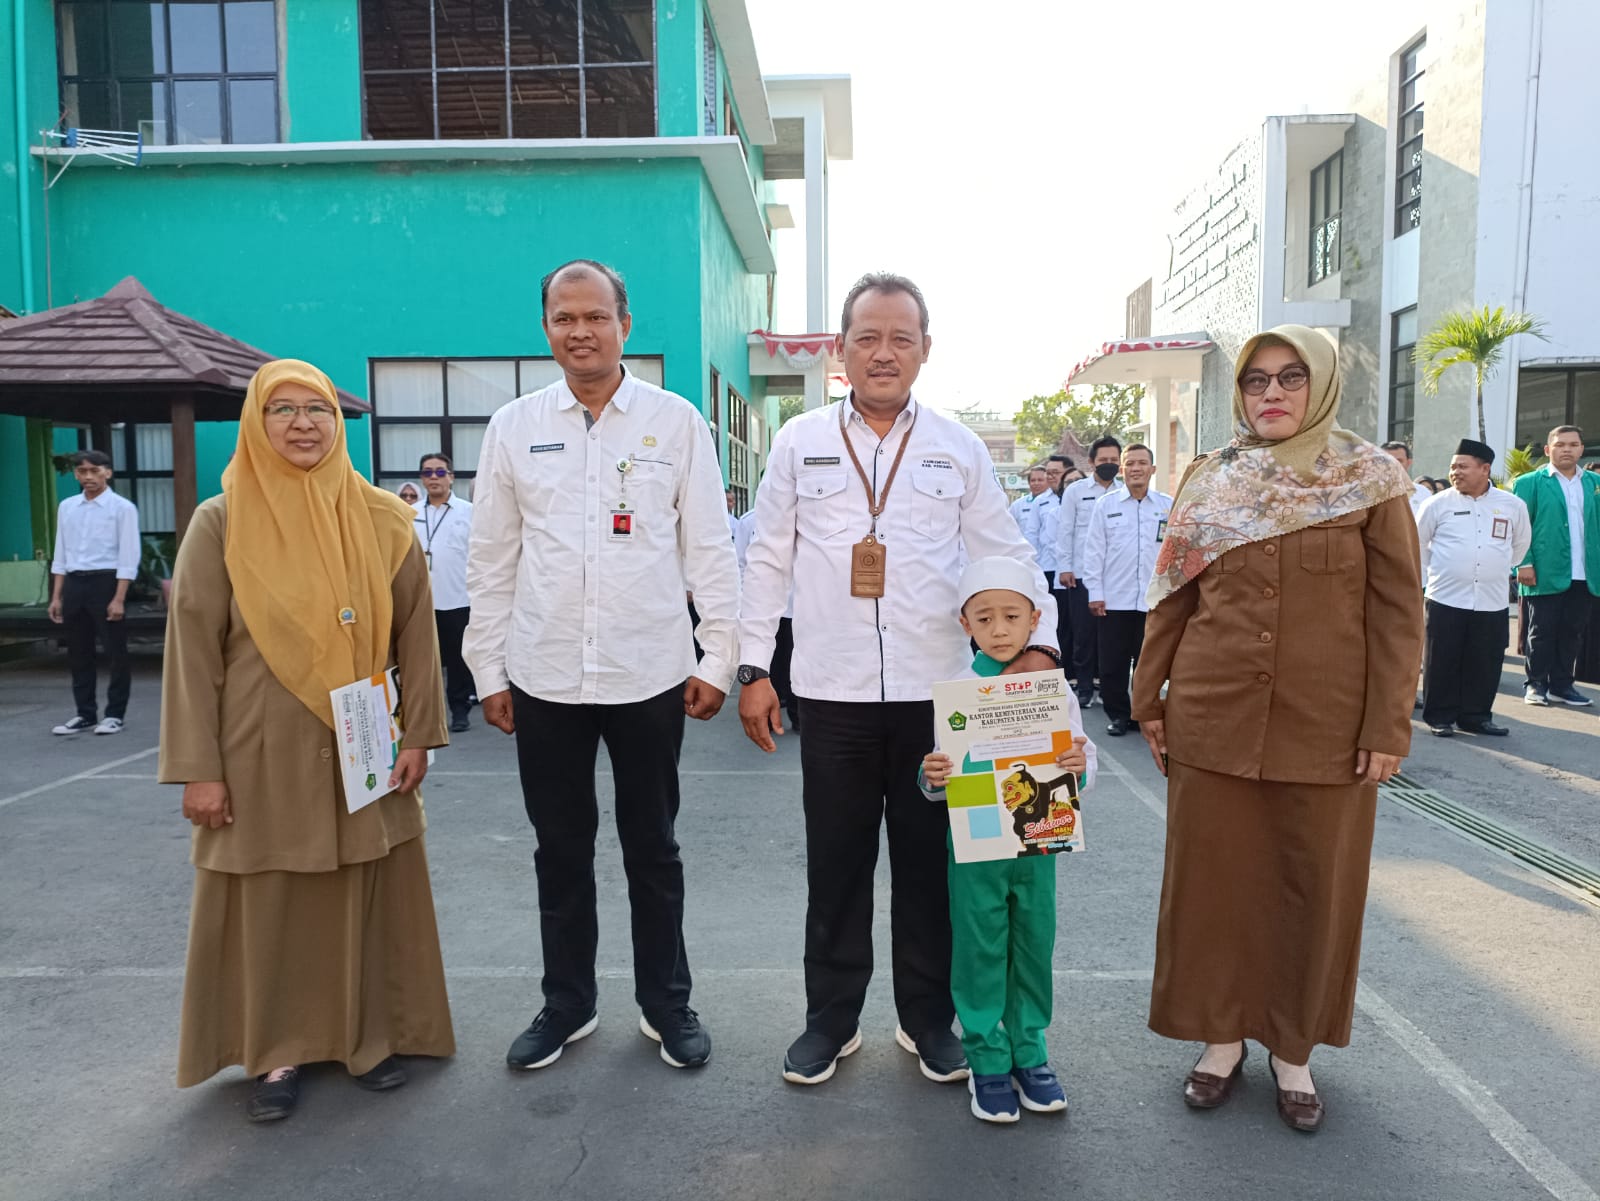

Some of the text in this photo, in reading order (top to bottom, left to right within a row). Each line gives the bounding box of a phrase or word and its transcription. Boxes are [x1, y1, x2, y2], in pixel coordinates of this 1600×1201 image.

[969, 704, 1060, 720] KANTOR KEMENTERIAN AGAMA
[981, 716, 1015, 726] KABUPATEN
[1016, 713, 1049, 722] BANYUMAS
[1024, 815, 1072, 838] Sibawor
